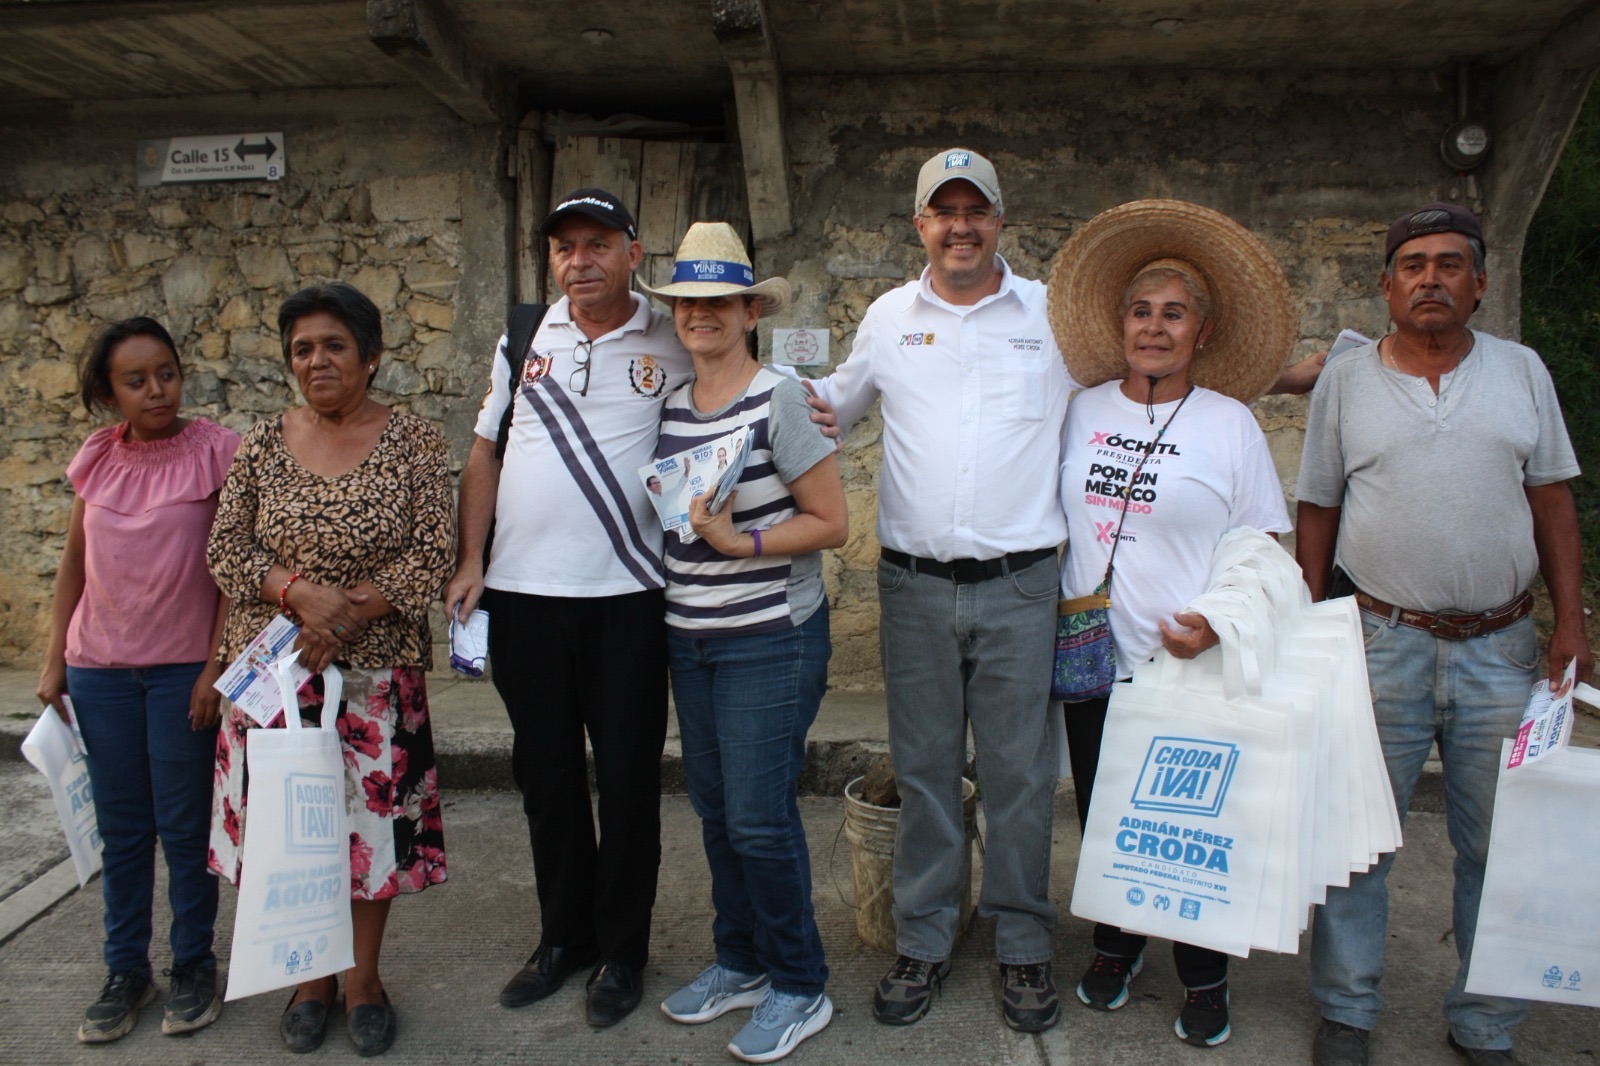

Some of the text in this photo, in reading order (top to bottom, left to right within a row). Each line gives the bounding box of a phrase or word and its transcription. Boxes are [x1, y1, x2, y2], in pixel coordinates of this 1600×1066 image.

[171, 148, 229, 164] Calle 15
[269, 166, 277, 177] 8
[693, 263, 725, 274] YUNES
[643, 366, 653, 383] 2
[655, 458, 676, 470] PEPE
[1089, 463, 1158, 485] POR UN
[1084, 494, 1152, 514] SIN MIEDO
[1547, 705, 1565, 750] CRODA
[1154, 746, 1223, 770] CRODA
[1149, 766, 1212, 800] ¡VA!
[1119, 816, 1234, 850] ADRIÁN PÉREZ
[1115, 829, 1229, 874] CRODA
[1112, 862, 1149, 874] DIPUTADO
[1150, 869, 1181, 882] FEDERAL
[1182, 876, 1213, 889] DISTRITO
[1213, 884, 1227, 892] XVI
[1141, 861, 1198, 878] CANDIDATO
[1129, 891, 1142, 900] PAN
